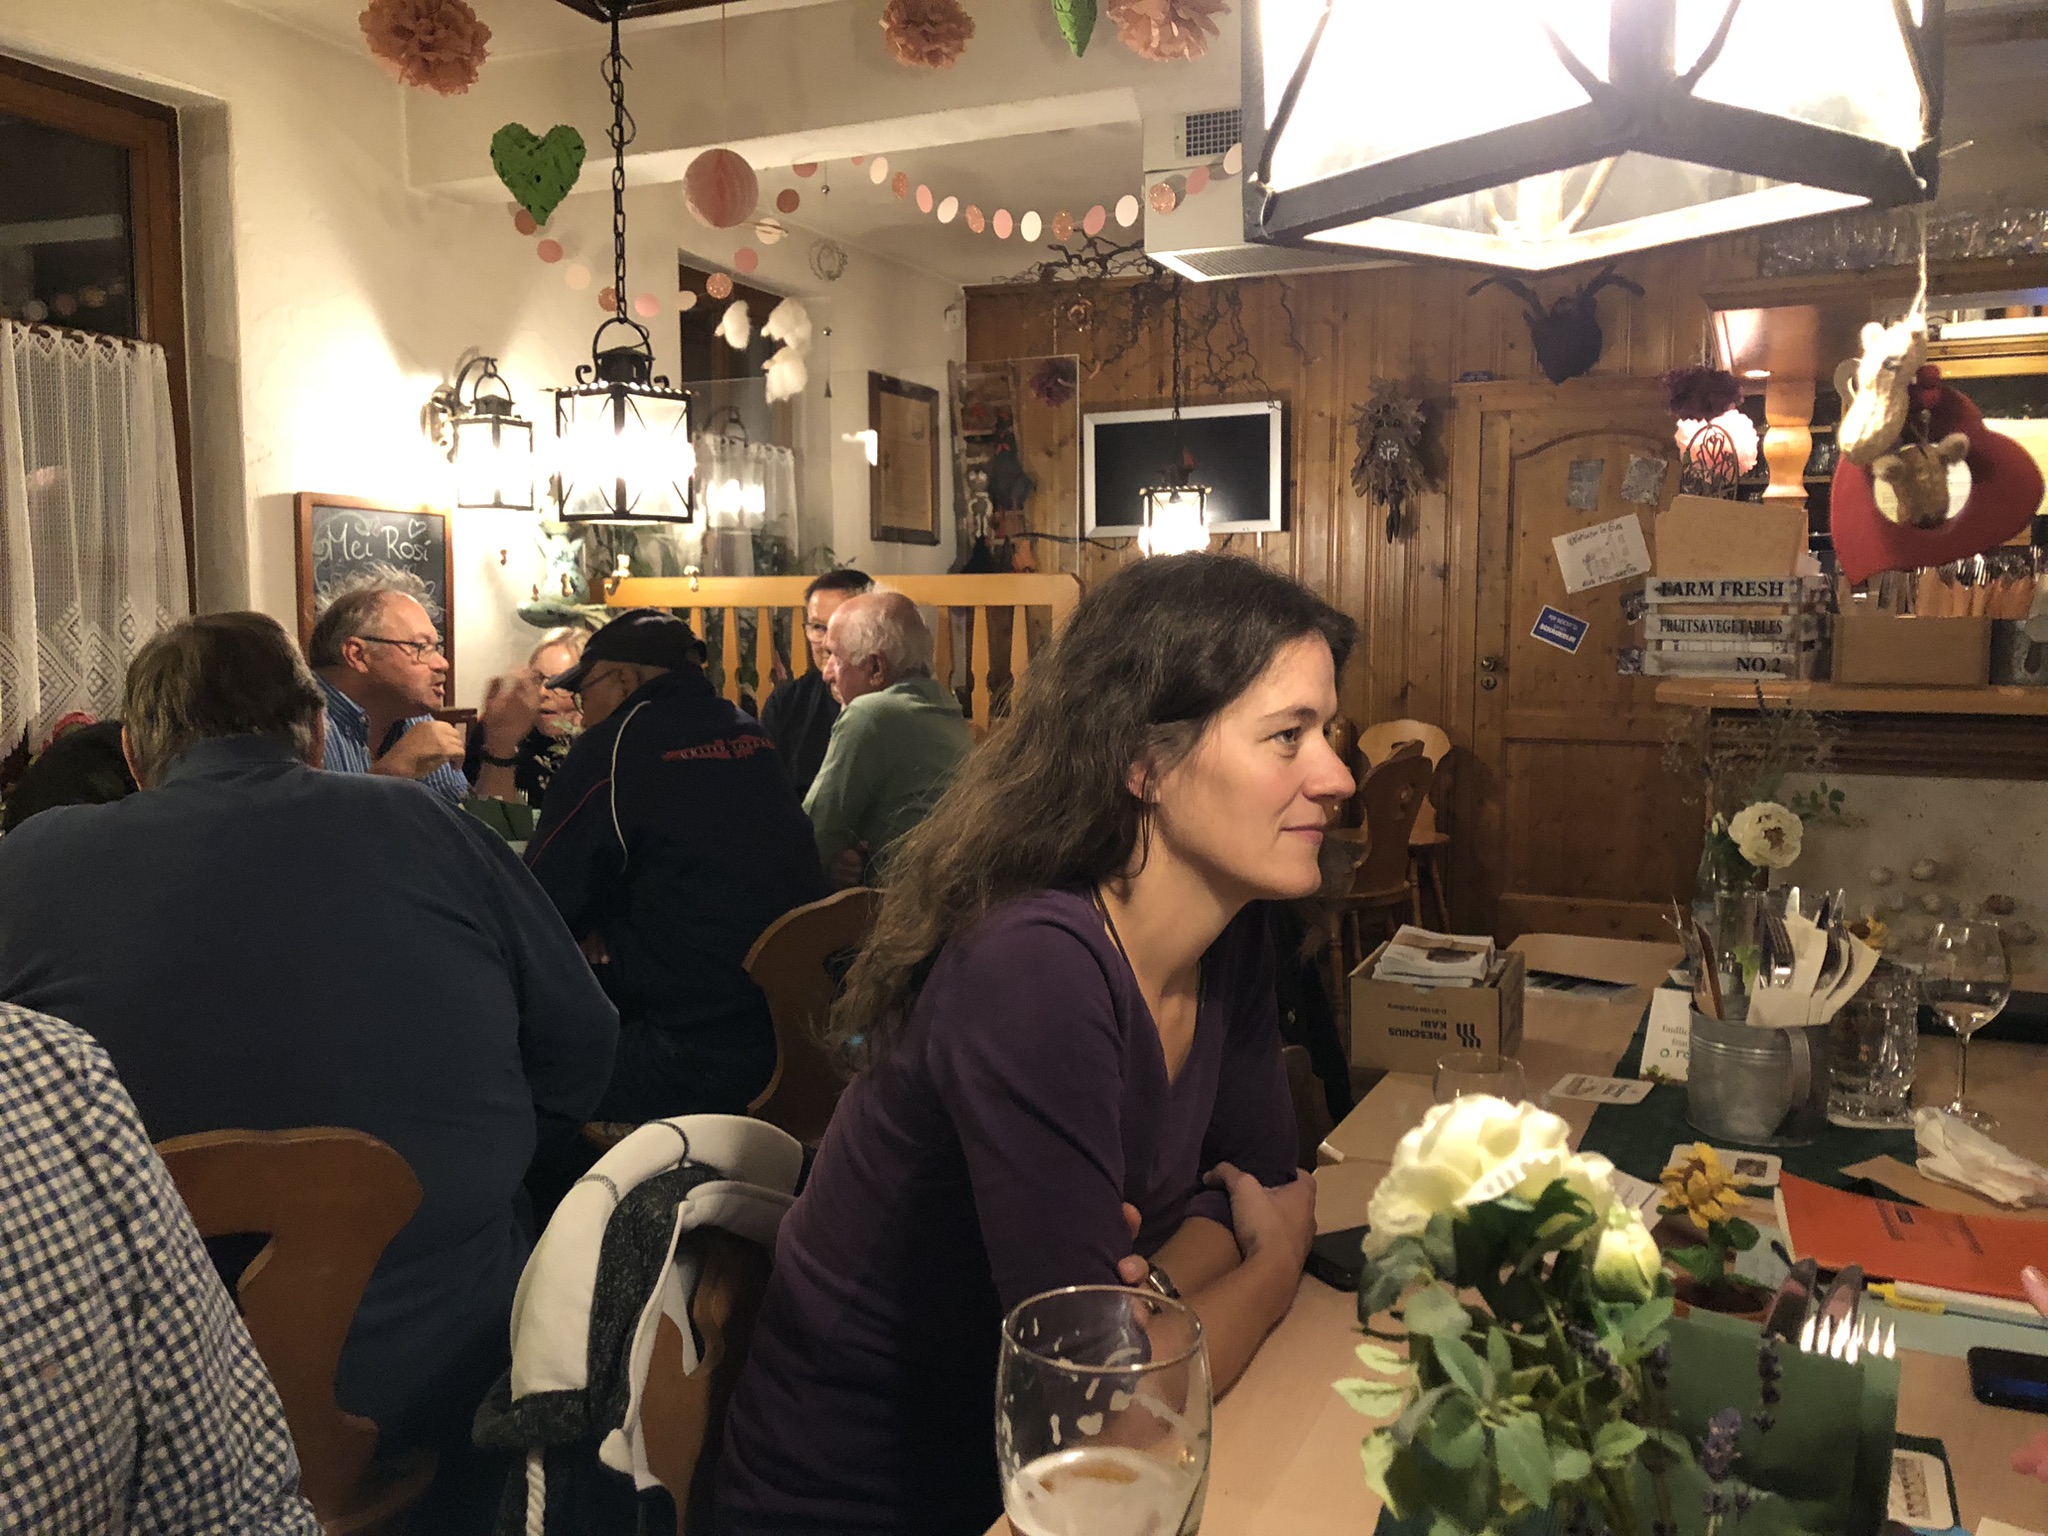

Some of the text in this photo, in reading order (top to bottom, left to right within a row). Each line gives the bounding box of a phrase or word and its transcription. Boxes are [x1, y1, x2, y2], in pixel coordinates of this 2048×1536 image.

[327, 522, 431, 562] Mei Rosi
[1660, 581, 1784, 597] FARM FRESH
[1736, 657, 1781, 673] NO.2
[1420, 1020, 1447, 1030] KABI
[1388, 1027, 1447, 1041] FRESENIUS
